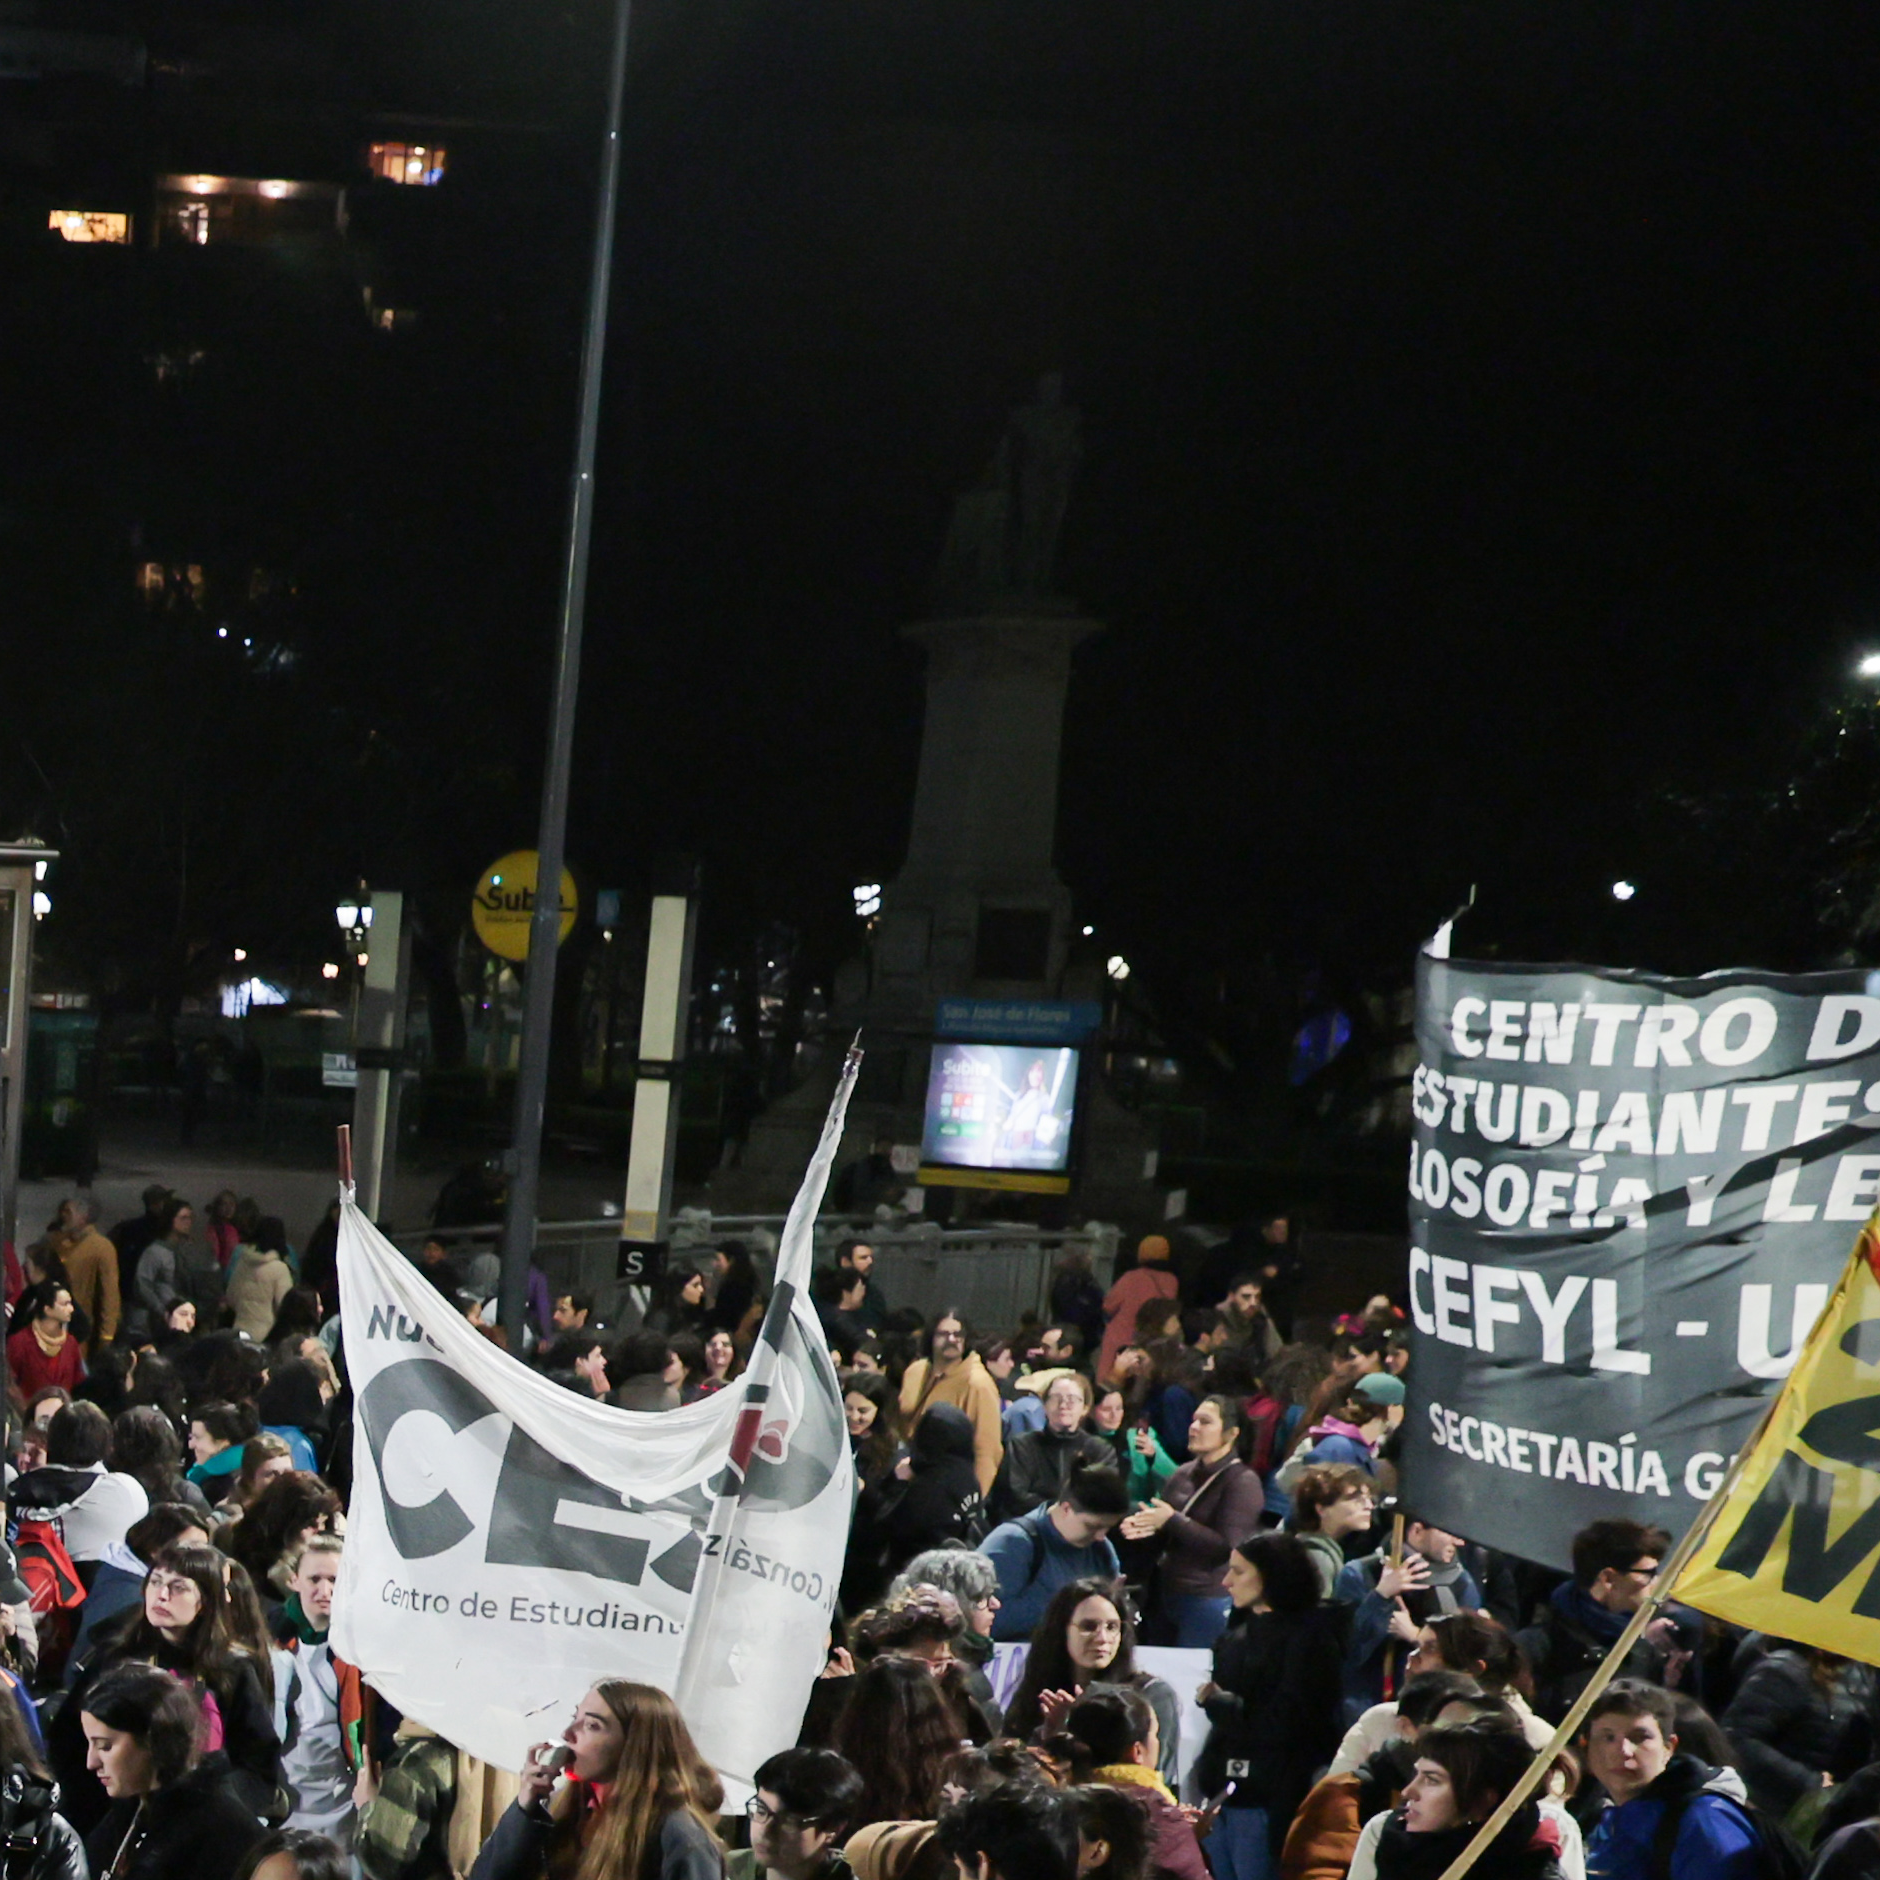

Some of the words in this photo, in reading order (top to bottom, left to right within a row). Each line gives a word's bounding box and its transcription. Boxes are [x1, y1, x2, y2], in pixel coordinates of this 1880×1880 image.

[1450, 996, 1778, 1068] CENTRO
[626, 1251, 644, 1275] S
[1409, 1247, 1651, 1375] CEFYL
[1430, 1403, 1671, 1498] SECRETARÍA
[381, 1579, 449, 1615] Centro
[459, 1591, 499, 1619] de
